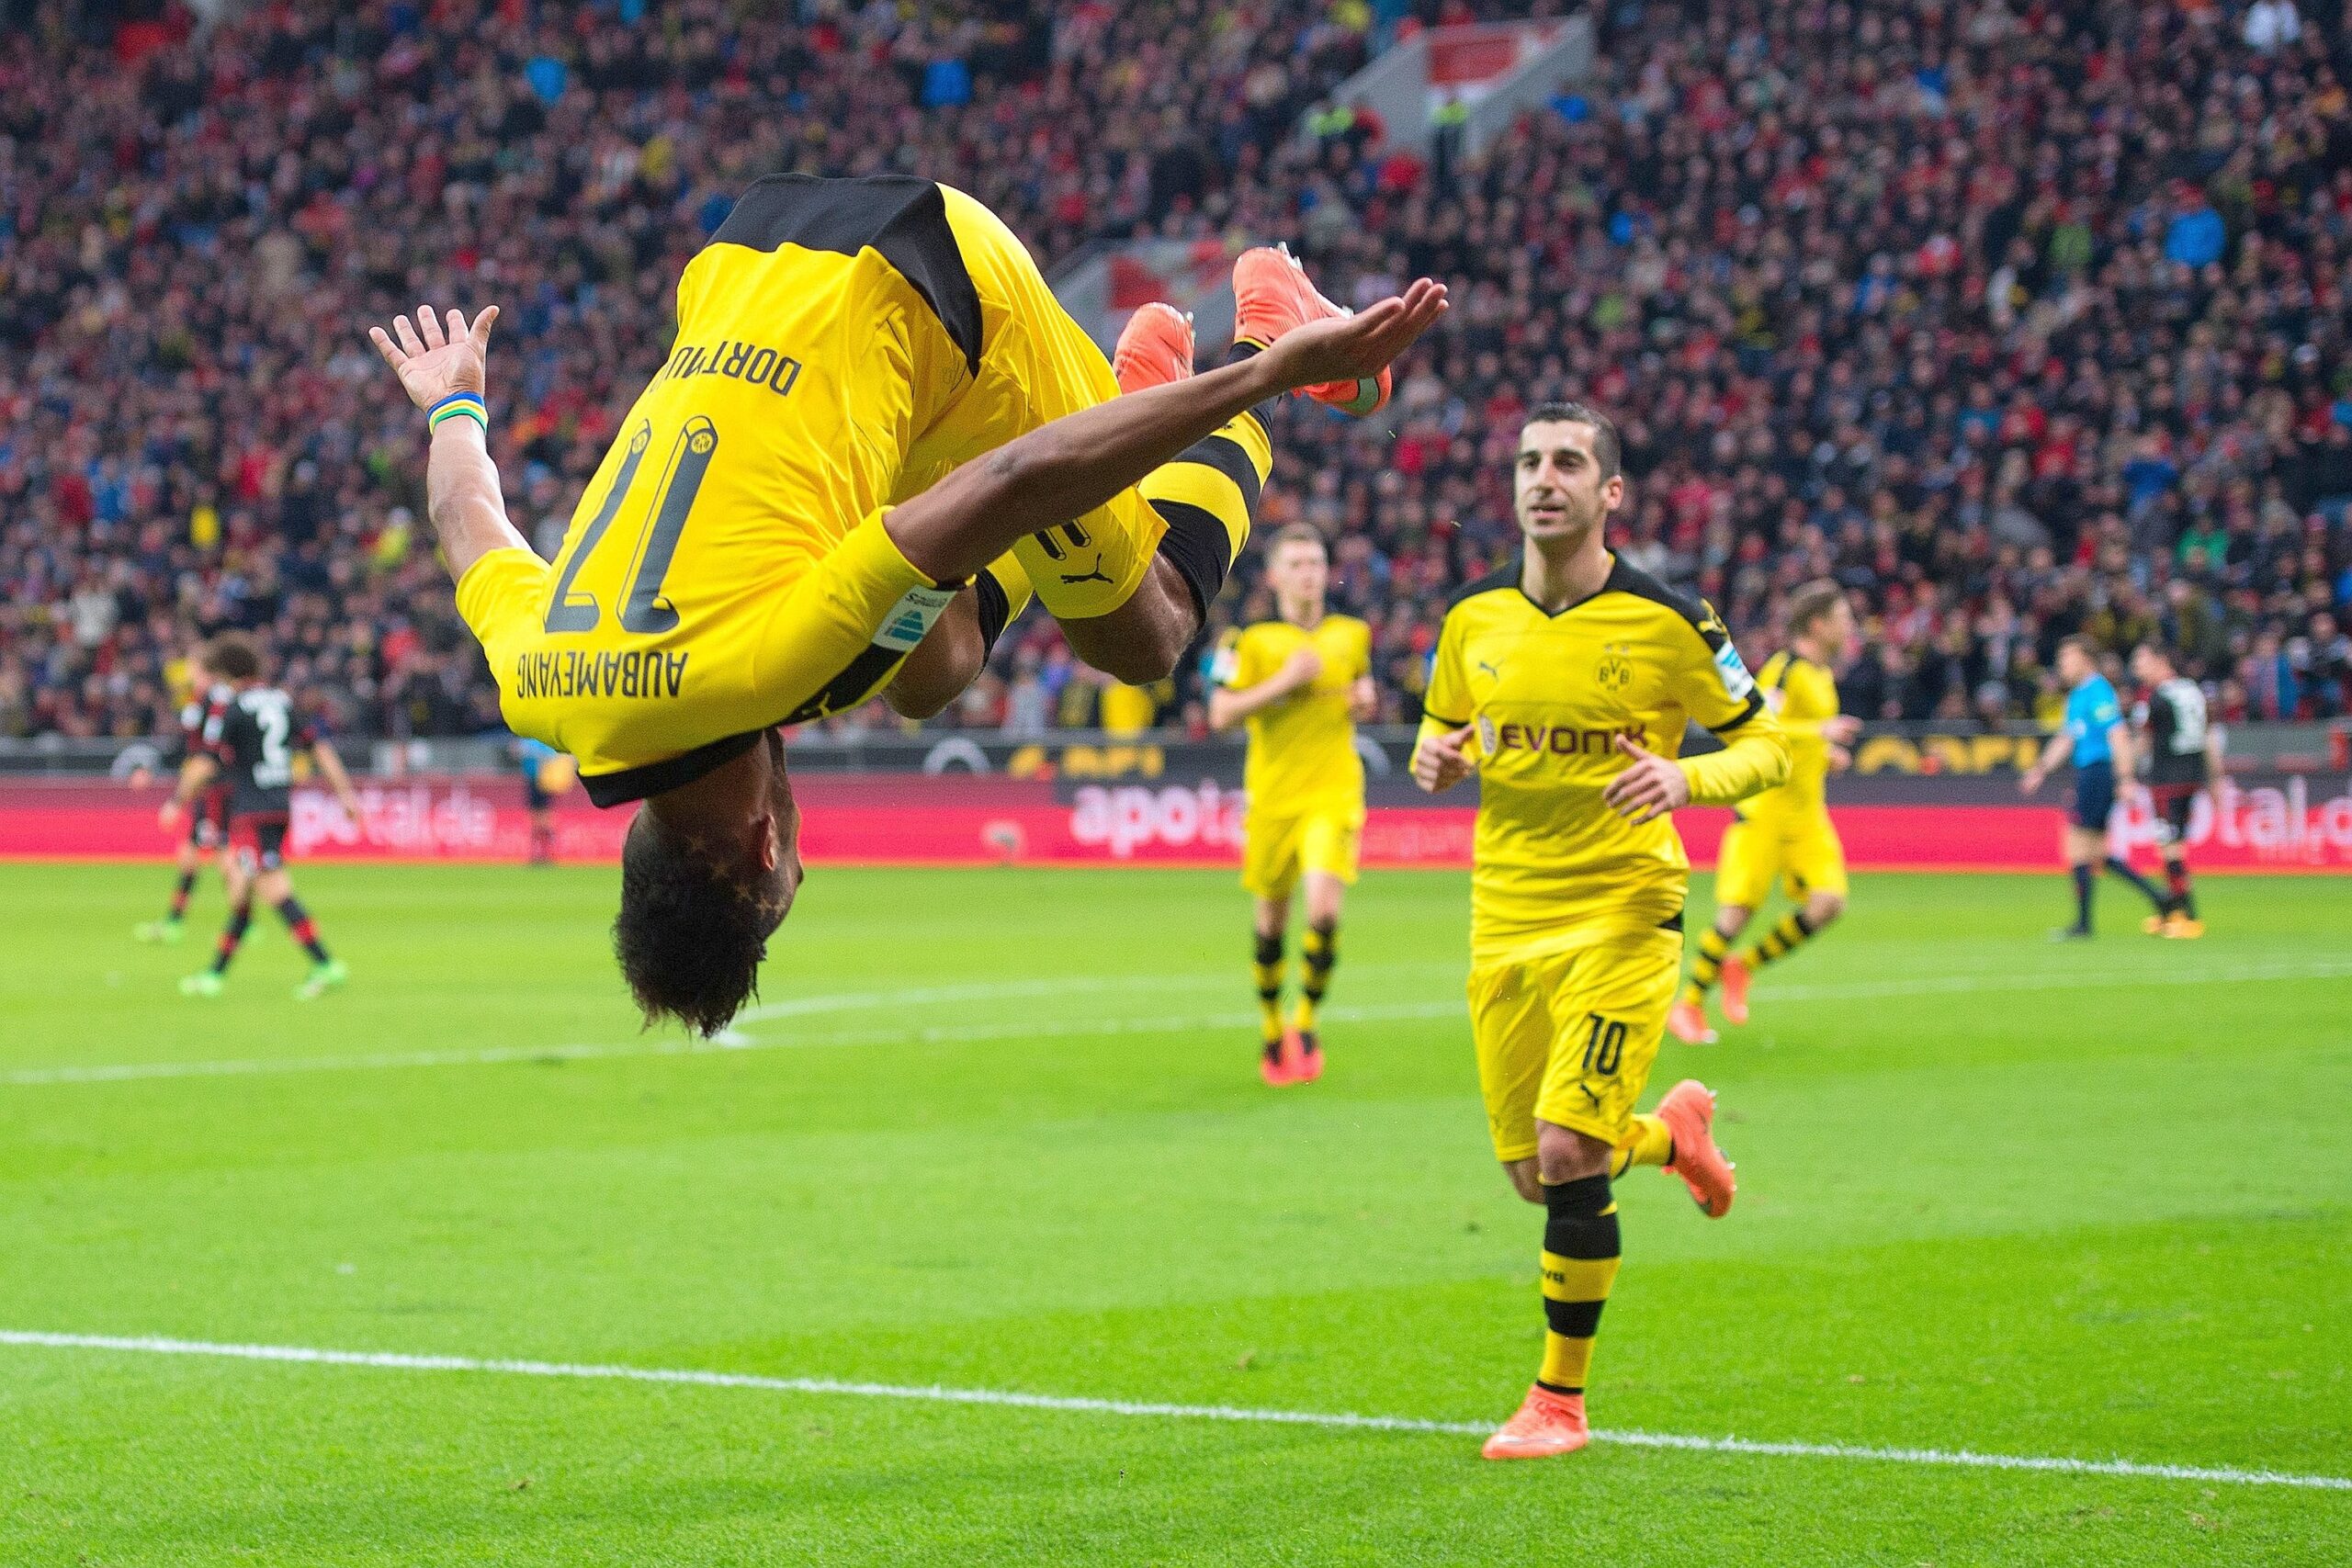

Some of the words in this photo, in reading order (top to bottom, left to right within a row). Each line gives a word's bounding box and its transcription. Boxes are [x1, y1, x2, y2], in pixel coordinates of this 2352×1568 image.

[650, 341, 802, 397] DORTMU
[543, 415, 718, 634] 17
[516, 651, 689, 698] AUBAMEYANG
[1582, 1011, 1627, 1076] 10
